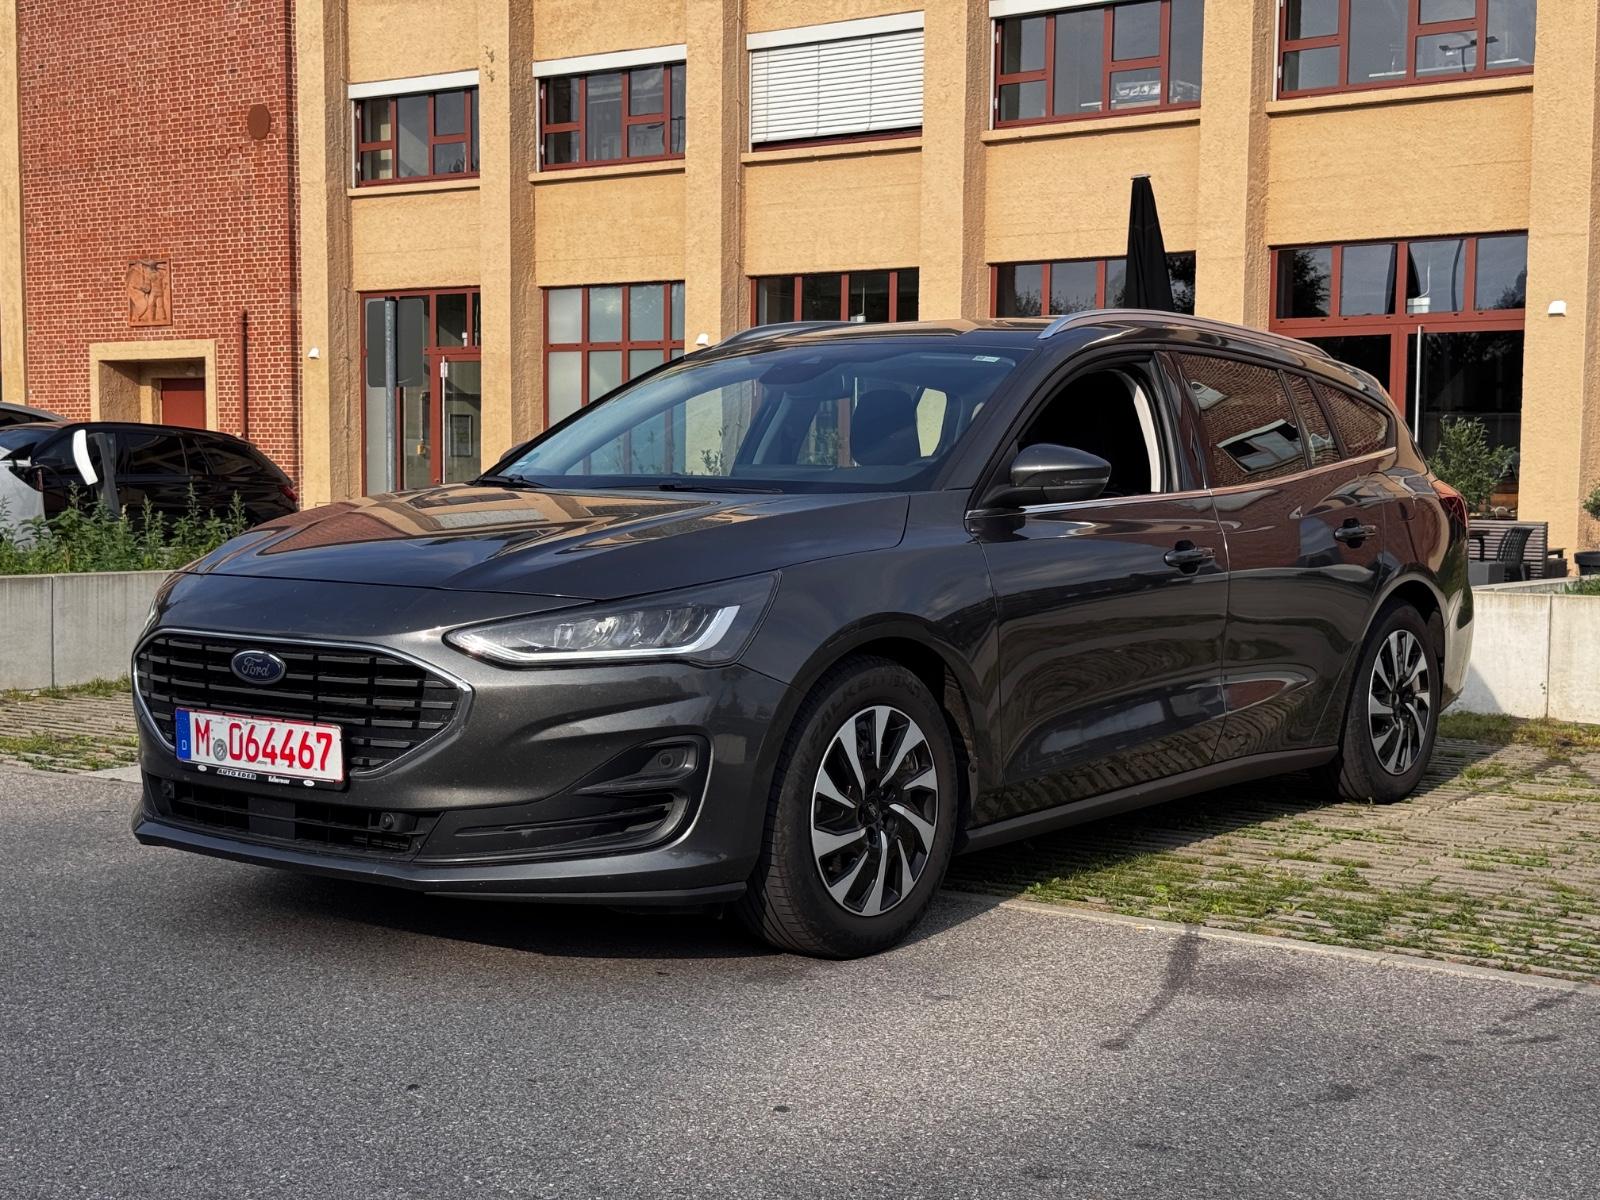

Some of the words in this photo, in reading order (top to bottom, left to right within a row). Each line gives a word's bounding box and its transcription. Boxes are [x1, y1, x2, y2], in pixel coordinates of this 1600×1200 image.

[242, 656, 270, 676] Ford
[181, 739, 187, 750] D
[195, 718, 211, 757] M
[229, 722, 333, 771] 064467
[218, 769, 236, 777] AUTO
